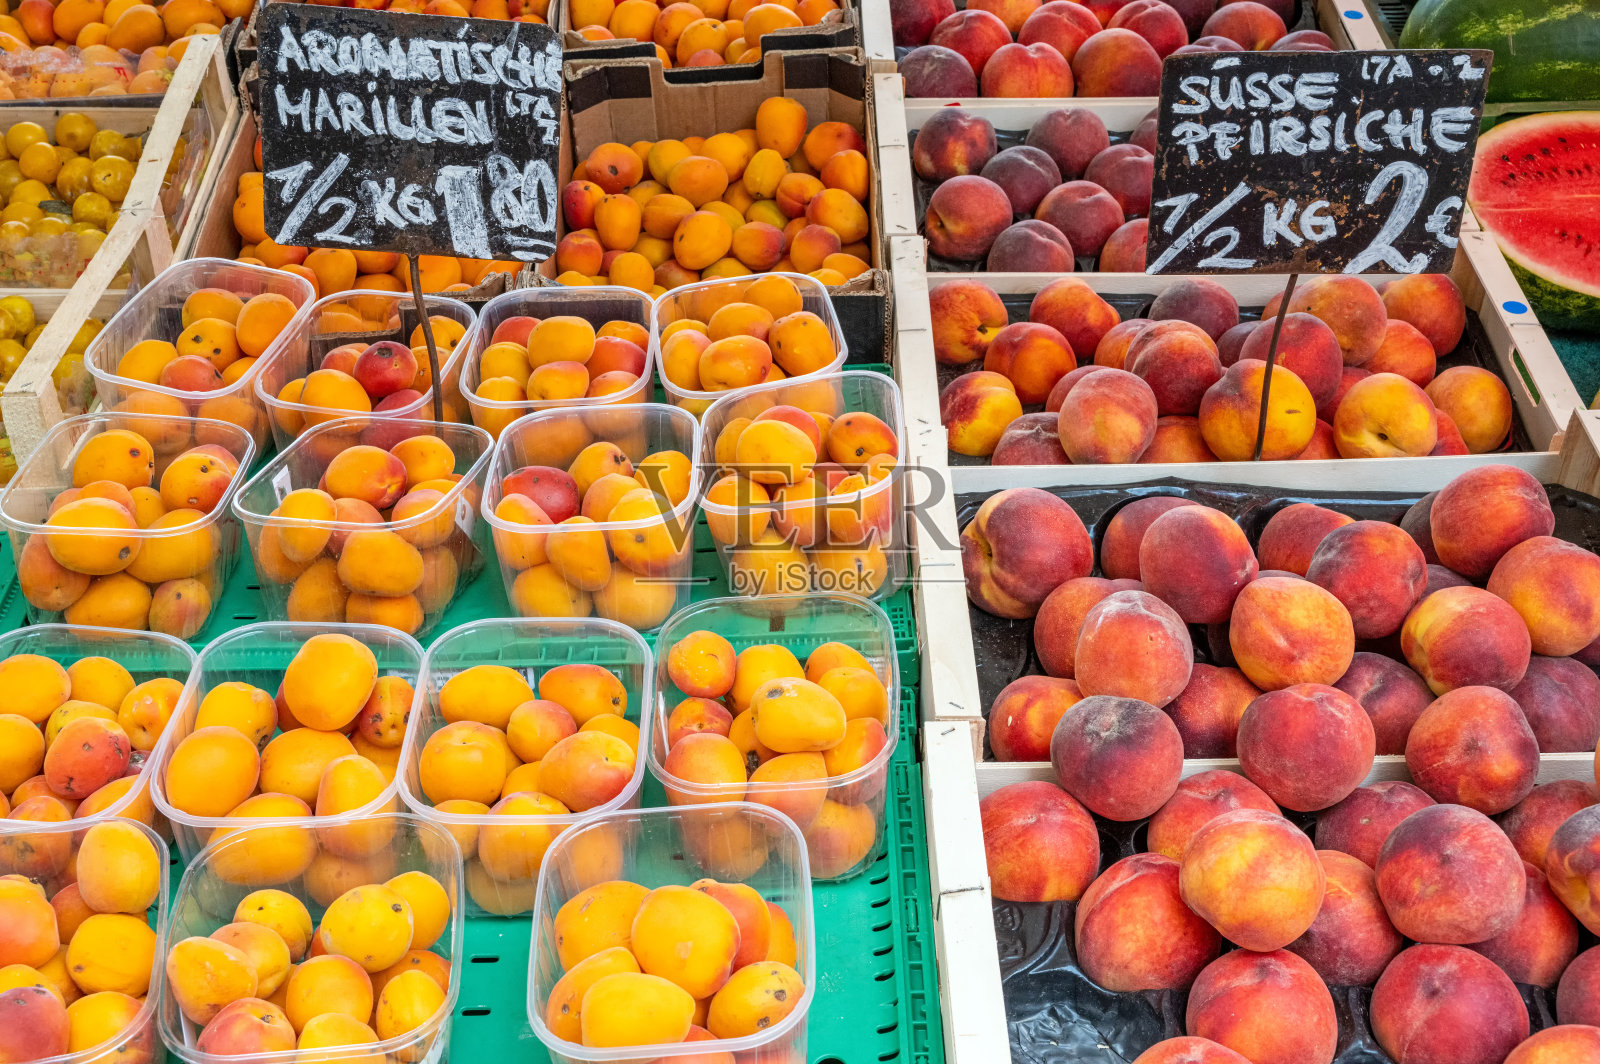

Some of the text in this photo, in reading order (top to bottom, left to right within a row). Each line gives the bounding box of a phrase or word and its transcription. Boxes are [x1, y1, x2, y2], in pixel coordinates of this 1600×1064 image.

[1171, 57, 1339, 114] SÜSSE
[1171, 106, 1475, 165] PFIRSICHE
[1263, 199, 1337, 247] KG
[1342, 160, 1429, 274] 2
[1425, 195, 1462, 249] €
